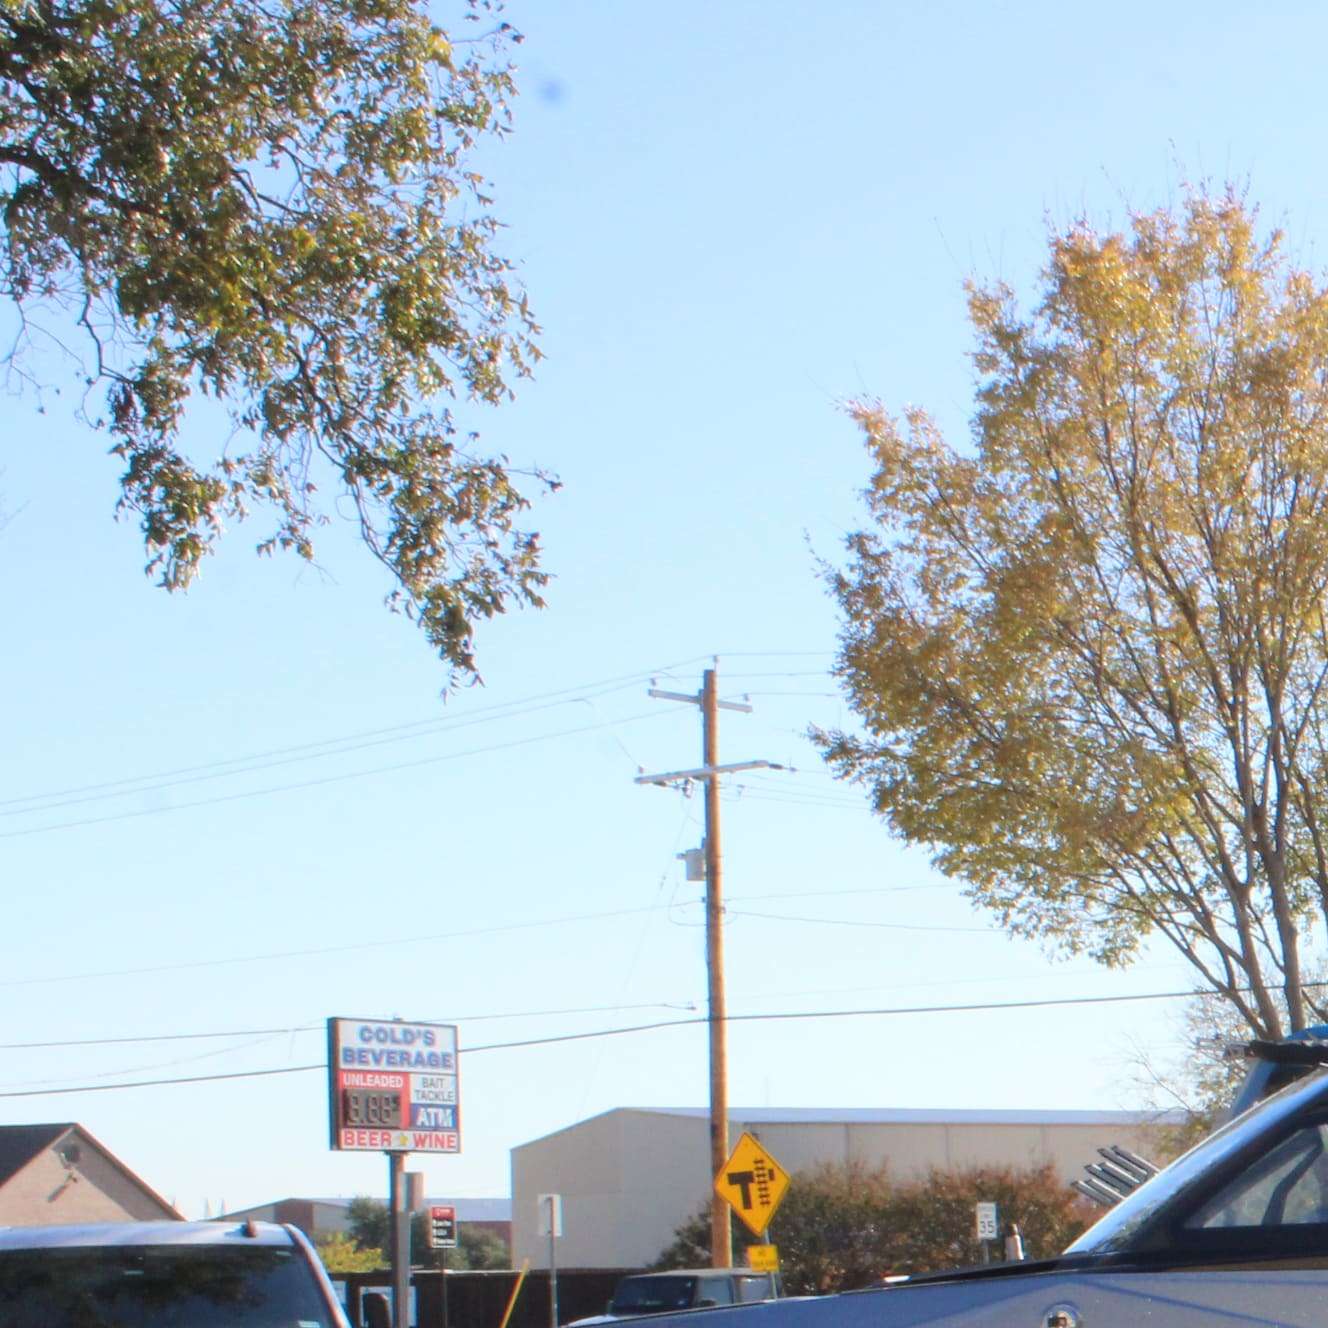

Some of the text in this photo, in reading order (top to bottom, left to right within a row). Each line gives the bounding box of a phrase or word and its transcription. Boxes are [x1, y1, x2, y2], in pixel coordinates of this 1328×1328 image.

[341, 1046, 454, 1070] BEVERAGE
[343, 1072, 403, 1089] UNLEADED
[421, 1077, 445, 1088] BAIT
[415, 1089, 456, 1103] TACKLE
[416, 1107, 454, 1128] ATM
[344, 1130, 457, 1149] BEER WINE
